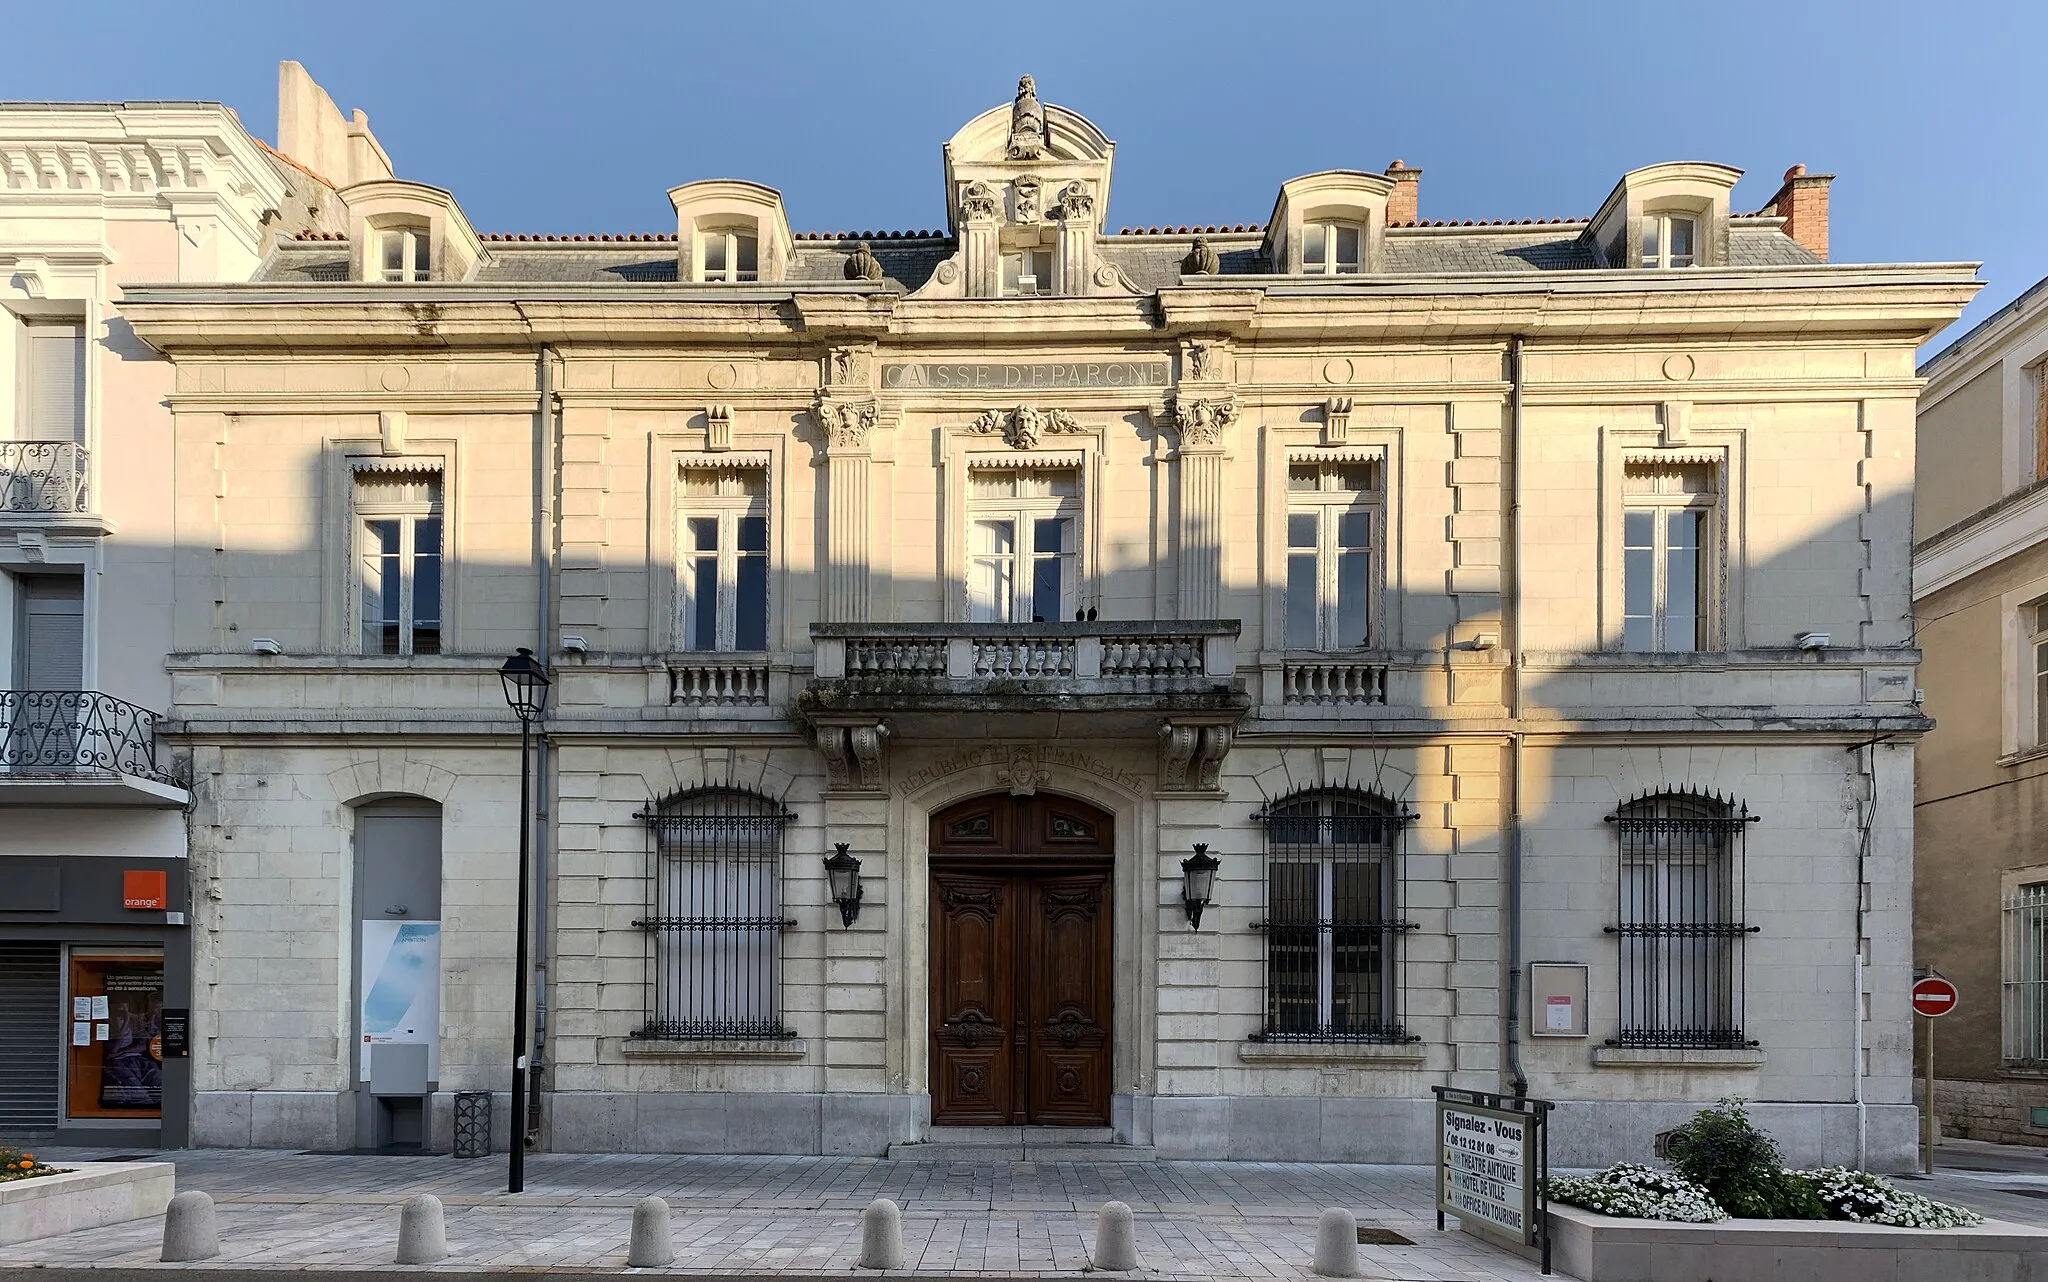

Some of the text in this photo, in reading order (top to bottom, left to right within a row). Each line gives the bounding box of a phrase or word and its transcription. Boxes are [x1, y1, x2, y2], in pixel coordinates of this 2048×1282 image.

[886, 364, 1166, 386] CAISSE D'EPARGNE
[125, 898, 158, 908] orange
[1446, 1111, 1486, 1133] Signalez
[1494, 1120, 1522, 1142] Vous
[1451, 1134, 1458, 1146] 06
[1460, 1136, 1467, 1148] 12
[1468, 1138, 1476, 1150] 12
[1477, 1140, 1485, 1153] 81
[1486, 1142, 1495, 1156] 08
[1487, 1160, 1517, 1183] ANTIQUE
[1480, 1179, 1488, 1197] DE
[1488, 1182, 1506, 1202] VILLE
[1462, 1194, 1522, 1230] OFFICE DU TOURISME
